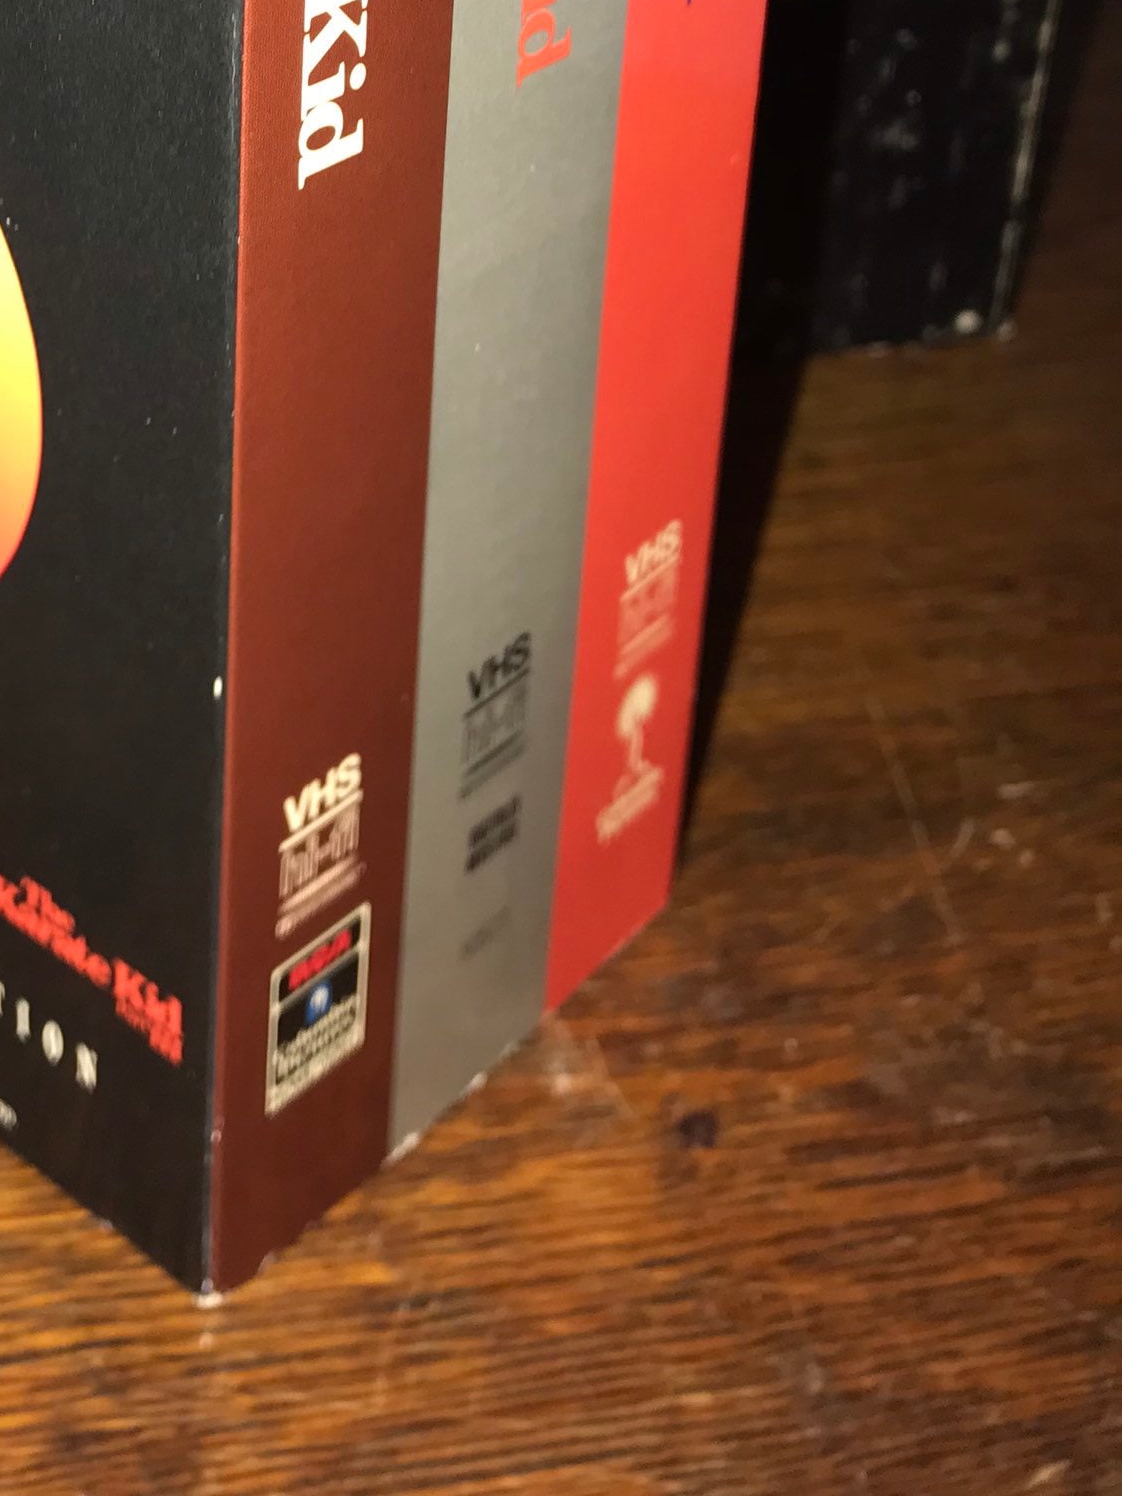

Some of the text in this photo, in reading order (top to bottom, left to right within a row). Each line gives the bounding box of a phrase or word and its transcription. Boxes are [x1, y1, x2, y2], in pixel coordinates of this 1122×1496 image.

[624, 518, 683, 585] VHS
[467, 631, 532, 703] VHS
[283, 752, 363, 834] VHS
